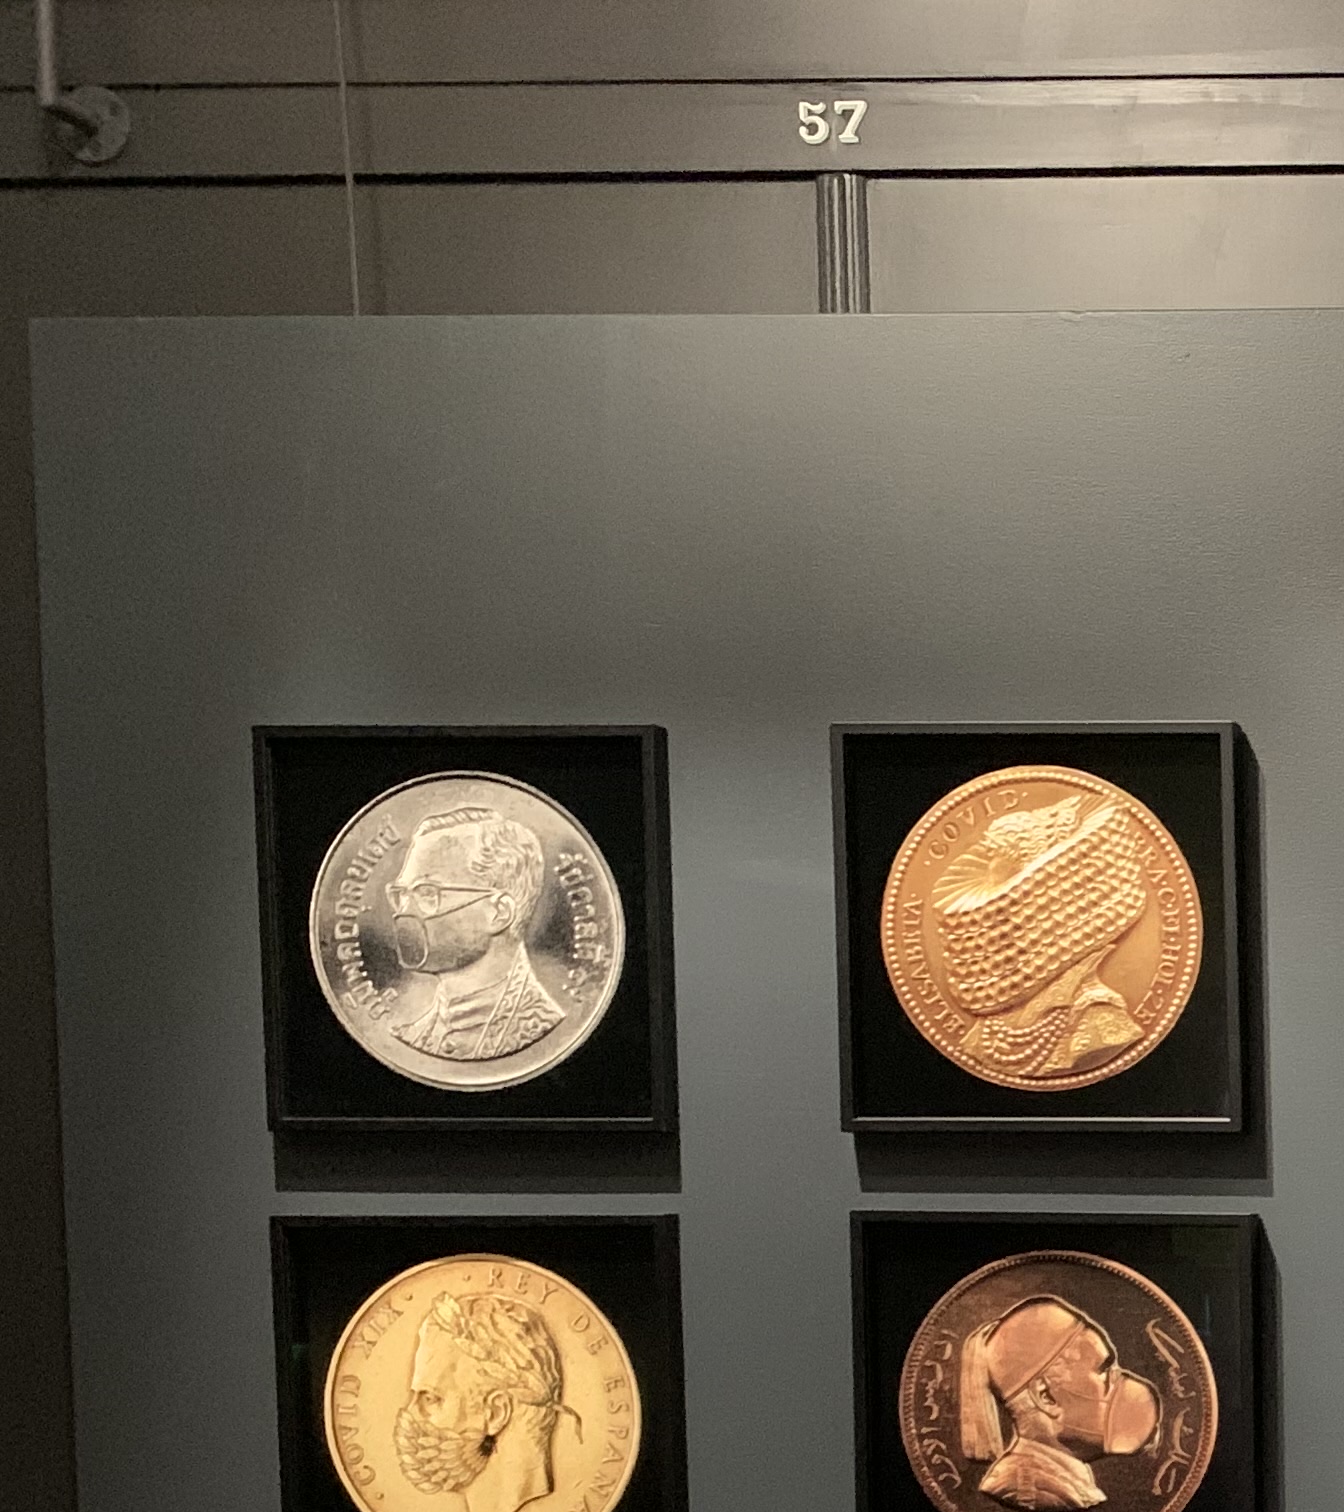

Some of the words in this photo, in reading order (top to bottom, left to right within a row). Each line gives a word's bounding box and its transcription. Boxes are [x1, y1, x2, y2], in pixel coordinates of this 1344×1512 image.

[798, 100, 867, 144] 57
[353, 1302, 405, 1360] XIX
[486, 1266, 560, 1306] REY
[570, 1312, 609, 1357] DE
[336, 1374, 377, 1487] COVID
